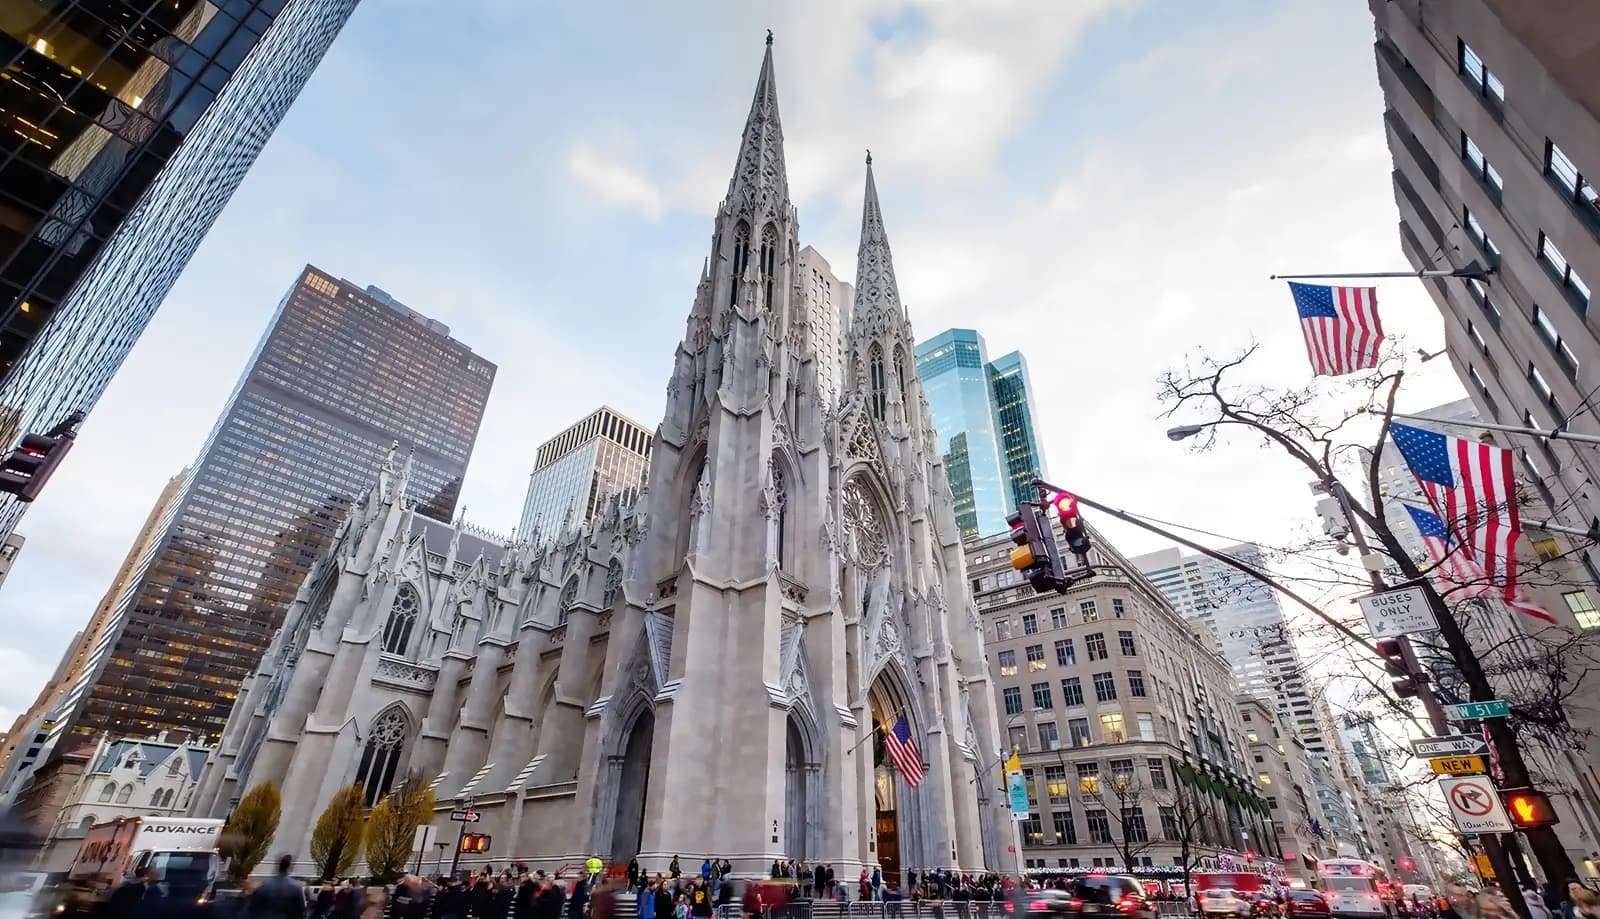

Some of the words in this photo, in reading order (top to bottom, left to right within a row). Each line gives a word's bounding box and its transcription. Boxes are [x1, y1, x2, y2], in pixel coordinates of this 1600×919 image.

[1371, 593, 1412, 607] BUSES
[1380, 604, 1410, 617] ONLY
[1457, 705, 1469, 717] W
[1476, 704, 1491, 716] 51
[1419, 744, 1441, 753] ONE
[1452, 740, 1475, 750] WAY
[1441, 759, 1471, 771] NEW
[144, 825, 216, 834] ADVANCE
